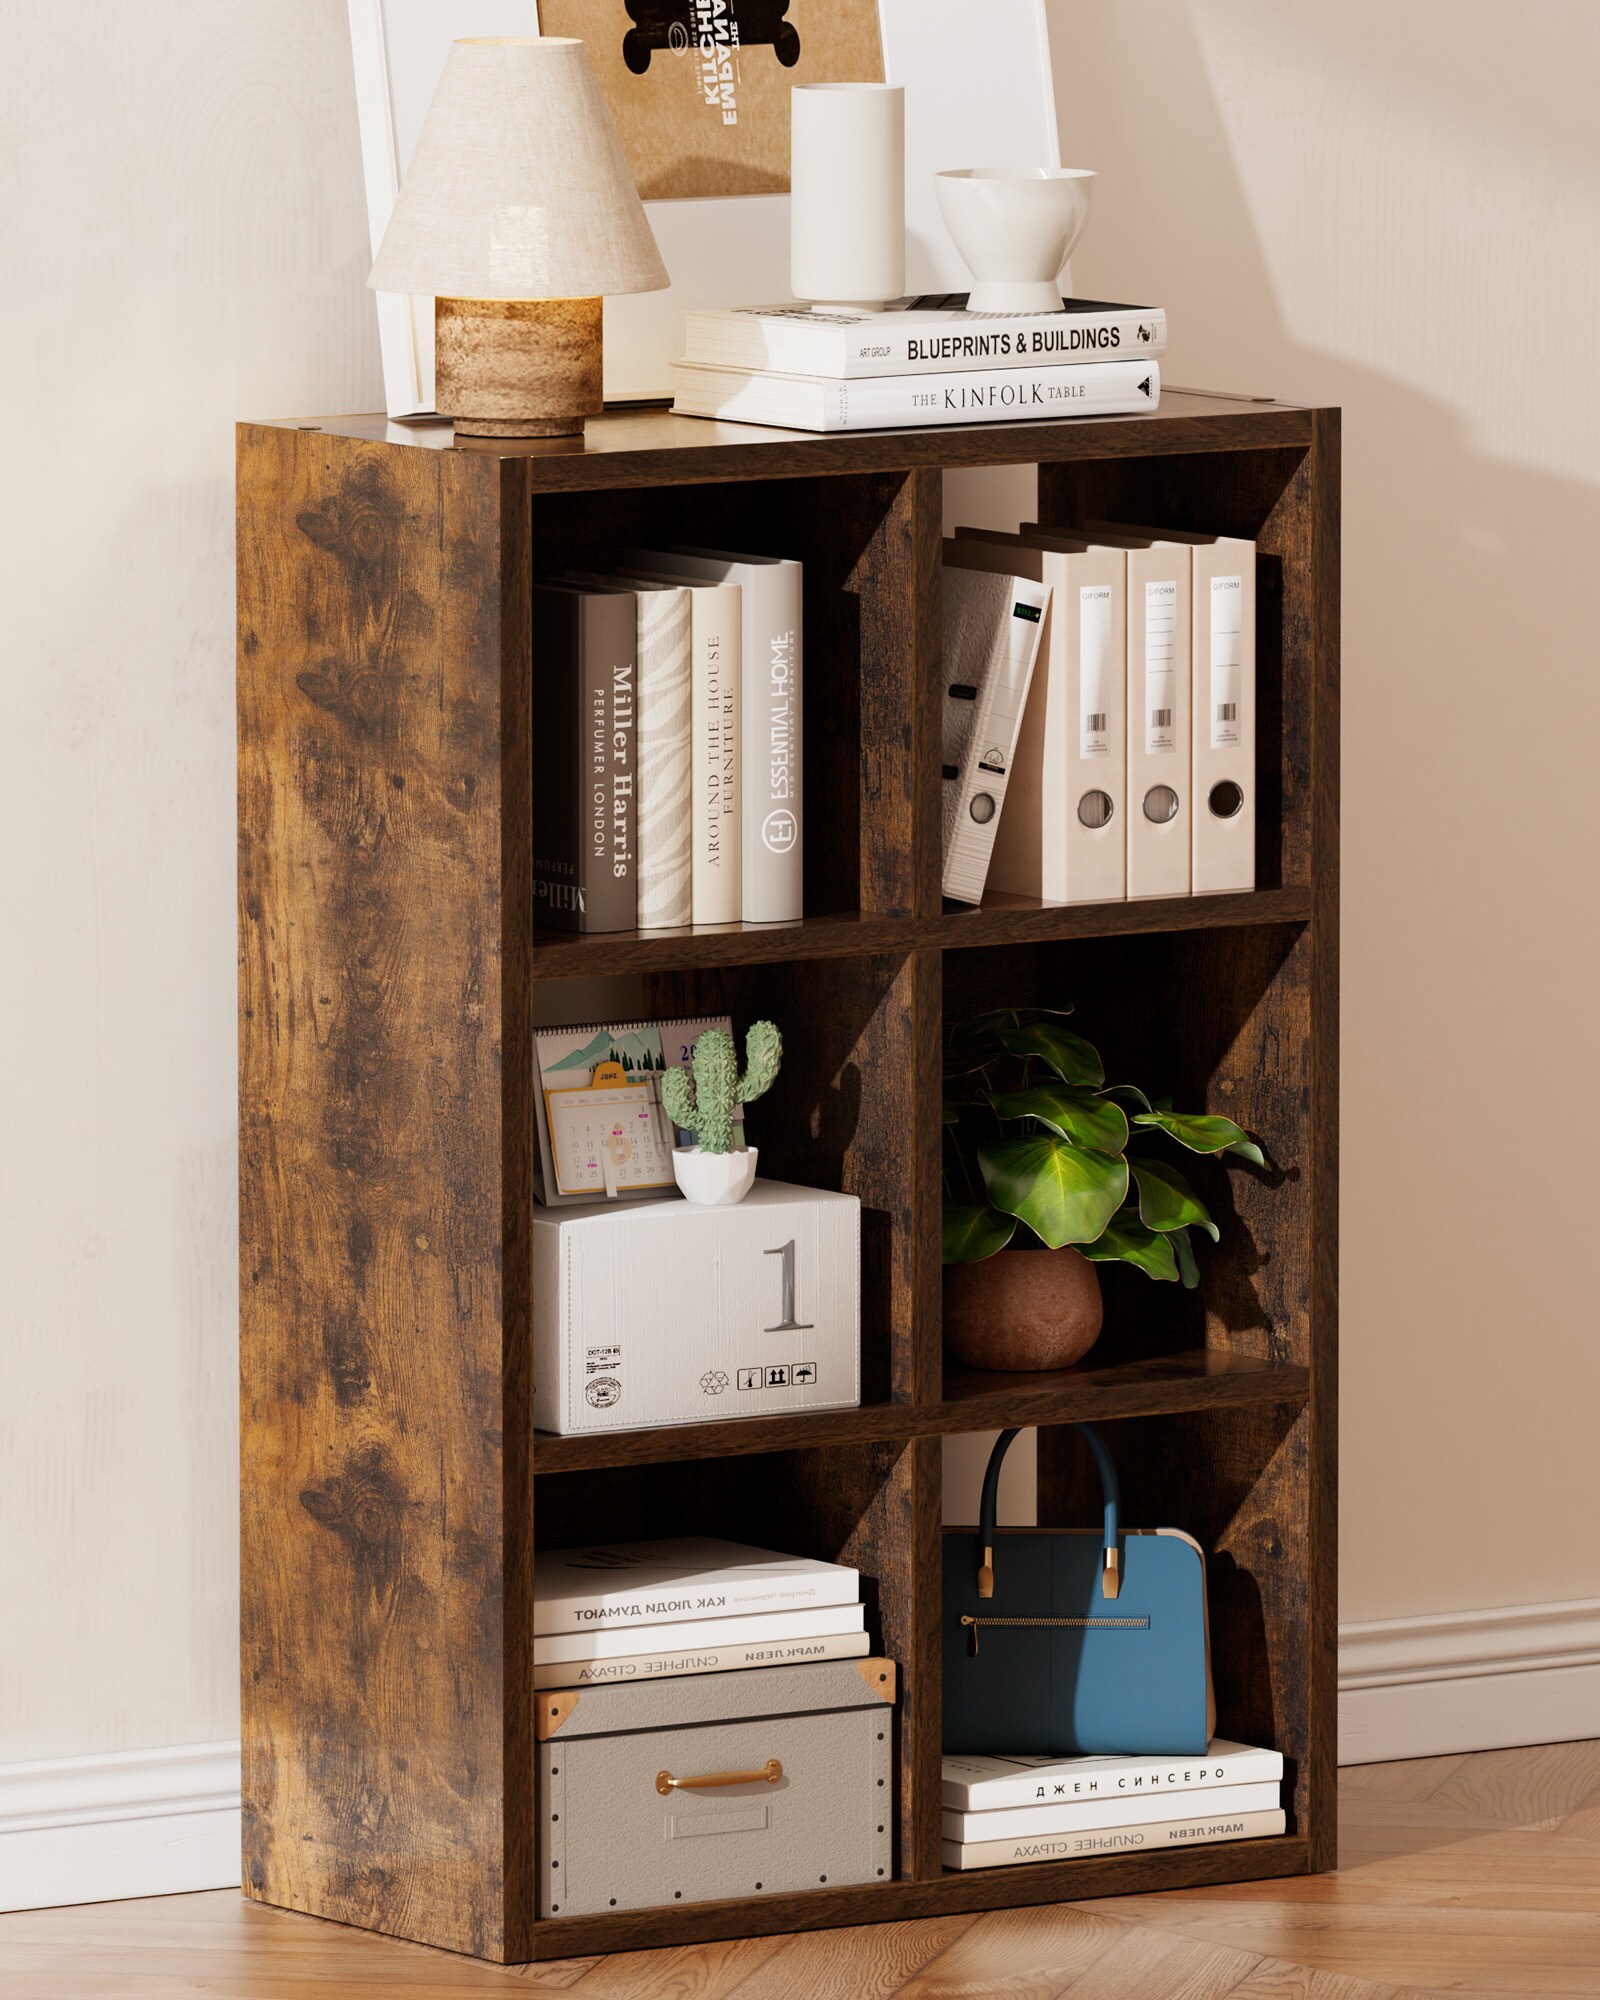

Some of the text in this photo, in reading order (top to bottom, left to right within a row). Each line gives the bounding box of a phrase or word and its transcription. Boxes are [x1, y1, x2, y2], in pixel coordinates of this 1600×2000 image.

[859, 346, 891, 358] ART GROUP
[907, 333, 1011, 360] BLUEPRINTS
[1016, 333, 1027, 353] &
[1032, 326, 1120, 352] BUILDINGS
[912, 383, 1086, 409] THE KINFOLK TABLE
[1082, 592, 1110, 600] GIFORM
[1148, 587, 1175, 596] GIFORM
[1213, 582, 1240, 590] GIFORM
[771, 632, 788, 800] ESSENTIAL HOME
[708, 636, 720, 867] AROUND THE HOUSE
[724, 687, 734, 815] FURNITURE
[594, 689, 605, 856] PERFUMER LONDON
[613, 664, 632, 878] Miller Harris
[600, 1072, 617, 1080] JUNE
[763, 1238, 815, 1333] 1
[1036, 1768, 1225, 1798] ДЖЕН СИНСЕРО
